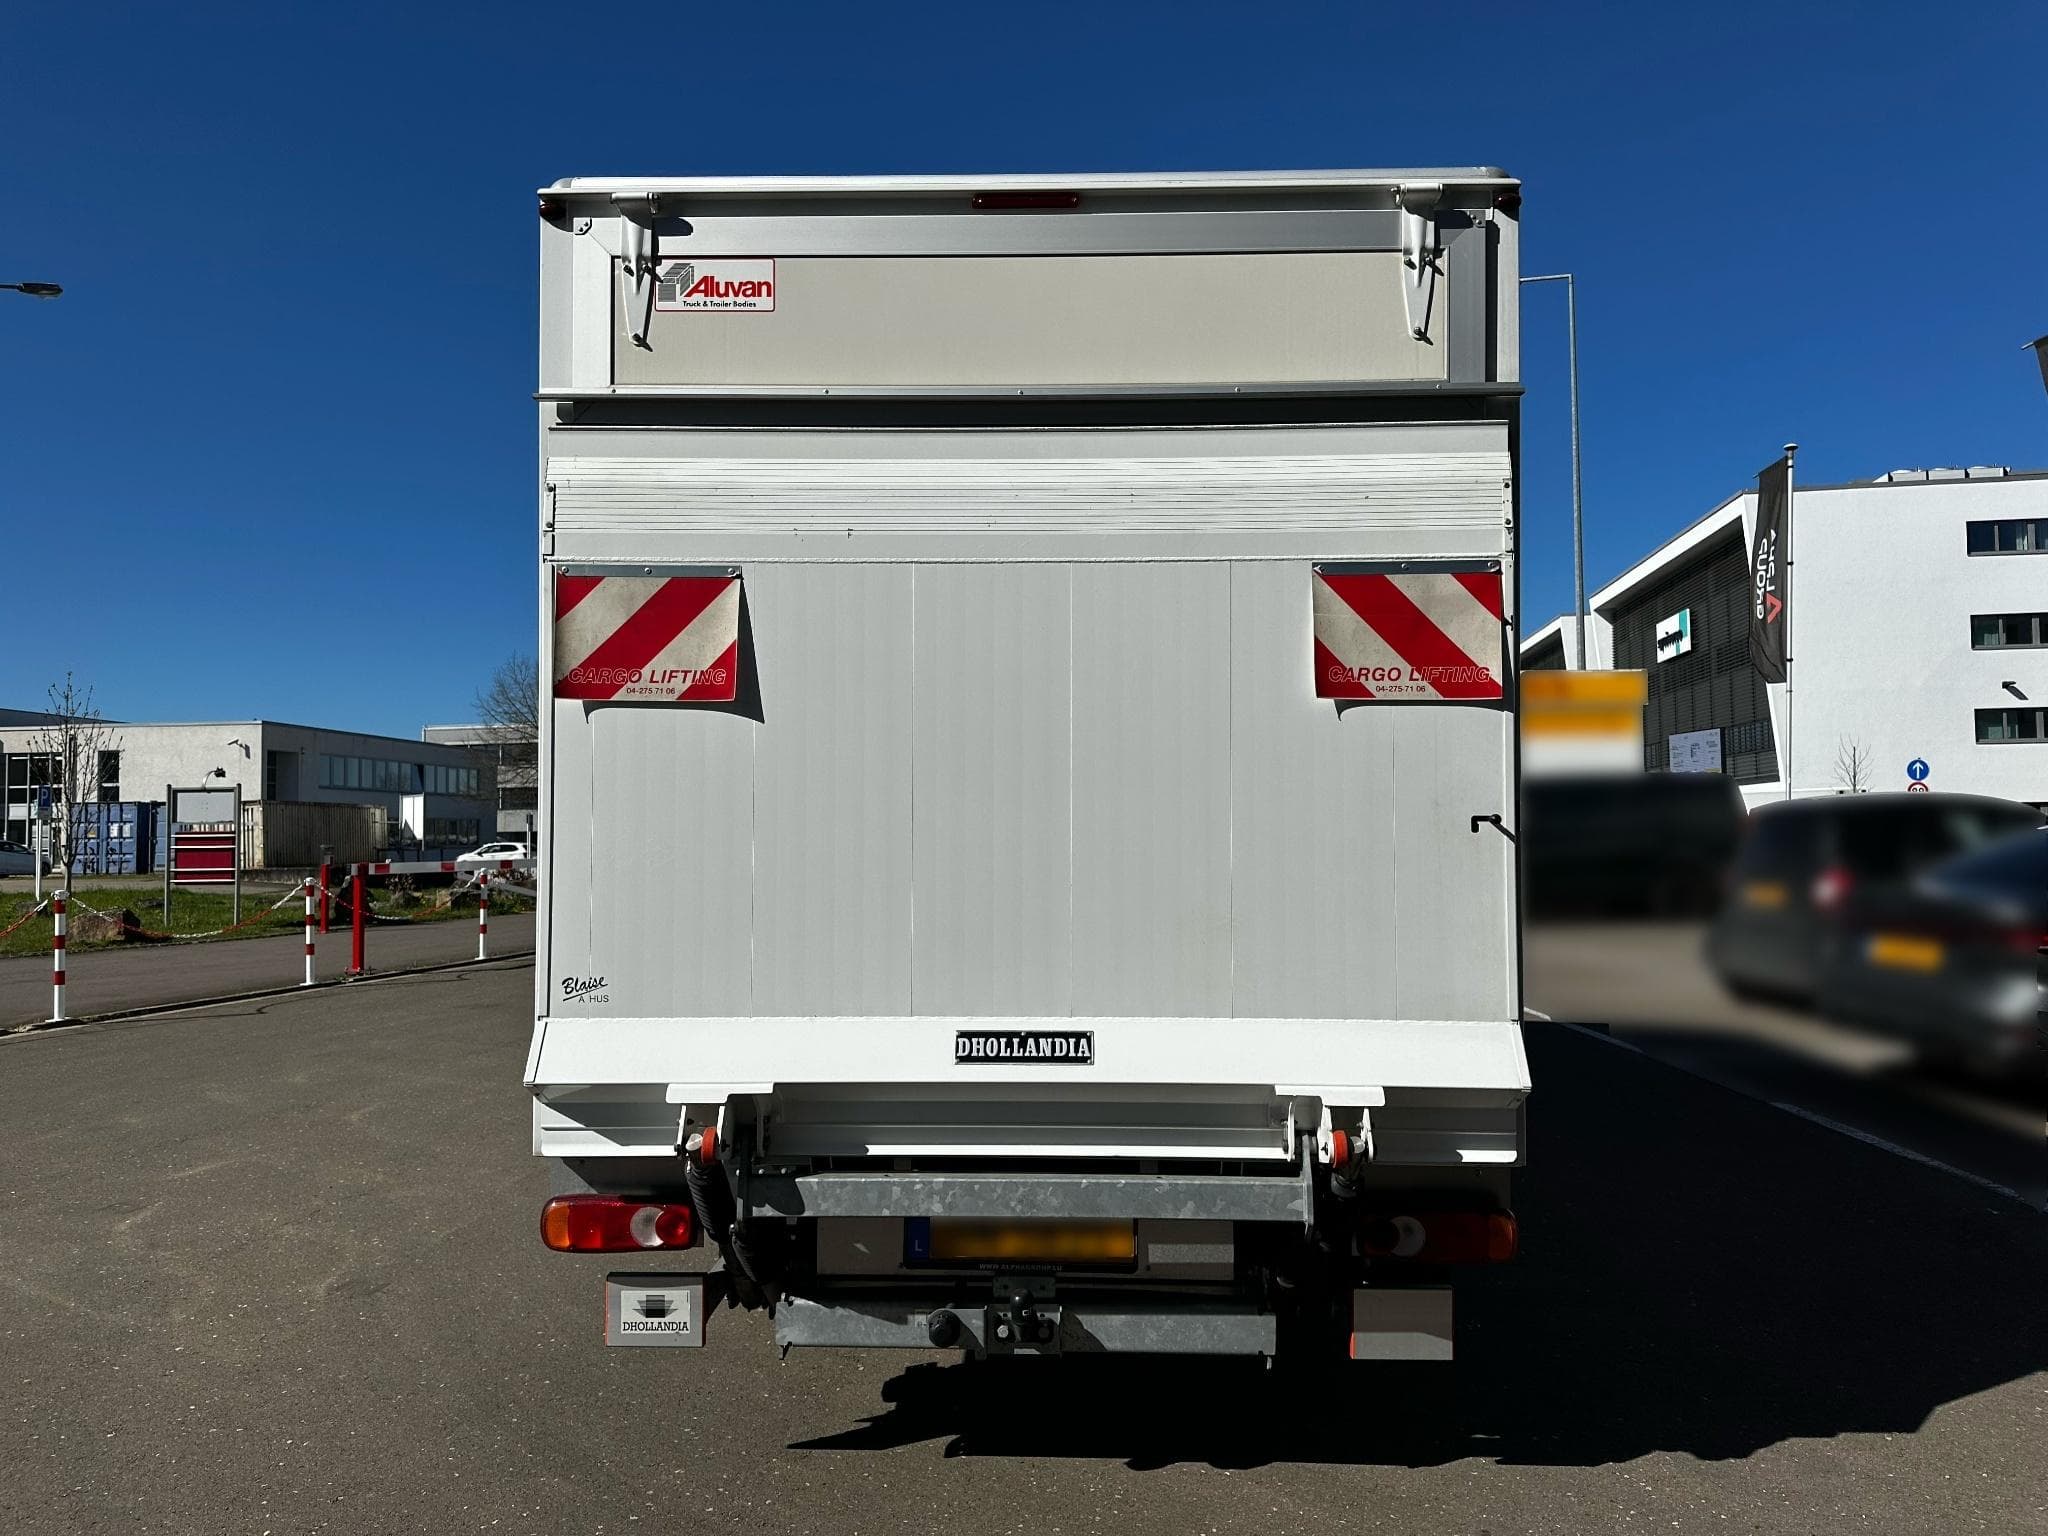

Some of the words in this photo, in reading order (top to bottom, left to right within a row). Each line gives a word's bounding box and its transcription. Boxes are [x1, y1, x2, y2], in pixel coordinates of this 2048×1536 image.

[683, 275, 772, 297] Aluvan
[568, 667, 643, 684] CARGO
[650, 668, 726, 685] LIFTING
[1328, 666, 1401, 682] CARGO
[1408, 666, 1491, 683] LIFTING
[626, 687, 653, 695] 04-275
[655, 687, 663, 695] 71
[665, 687, 676, 695] 06
[1416, 685, 1426, 693] 06
[41, 788, 49, 806] P
[562, 976, 608, 995] Blaise
[956, 1037, 1091, 1057] DHOLLANDIA
[915, 1239, 923, 1251] L
[622, 1321, 689, 1332] DHOLLANDIA
